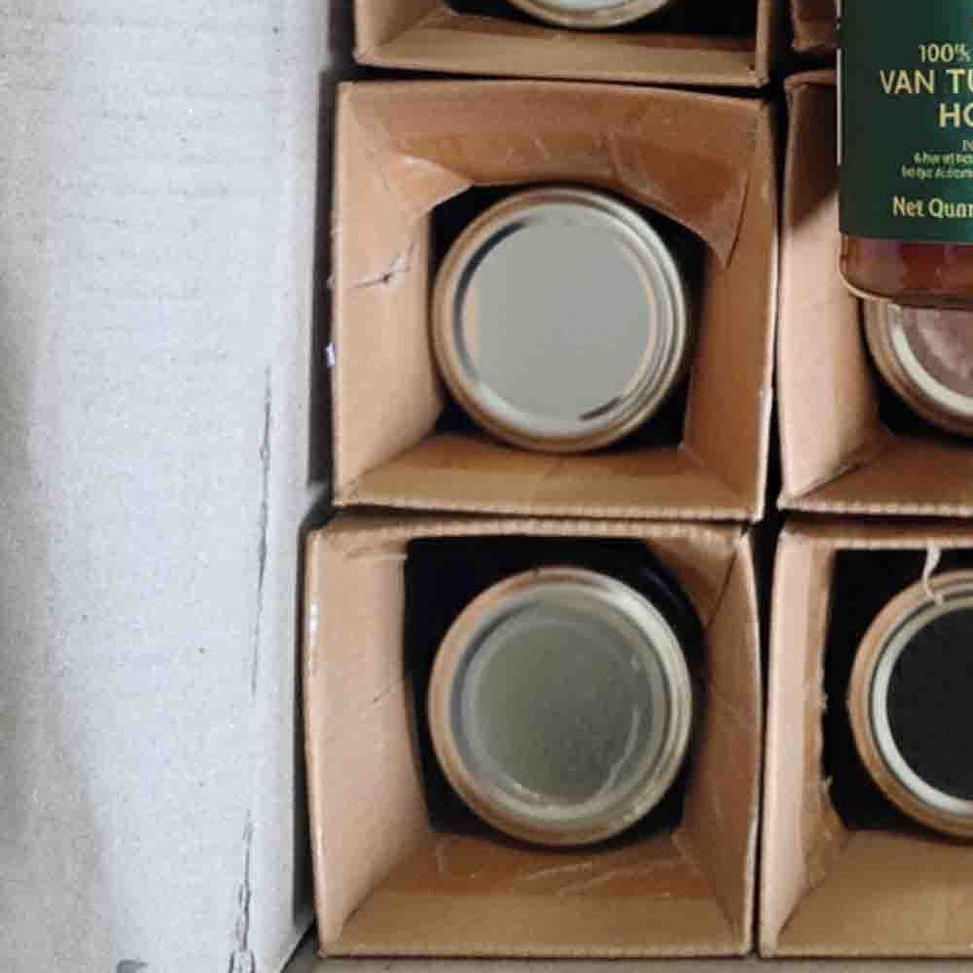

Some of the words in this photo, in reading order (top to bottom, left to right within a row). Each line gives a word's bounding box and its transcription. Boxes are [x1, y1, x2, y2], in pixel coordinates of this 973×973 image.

[918, 42, 971, 63] 100%
[879, 68, 935, 94] VAN
[892, 195, 924, 218] Net
